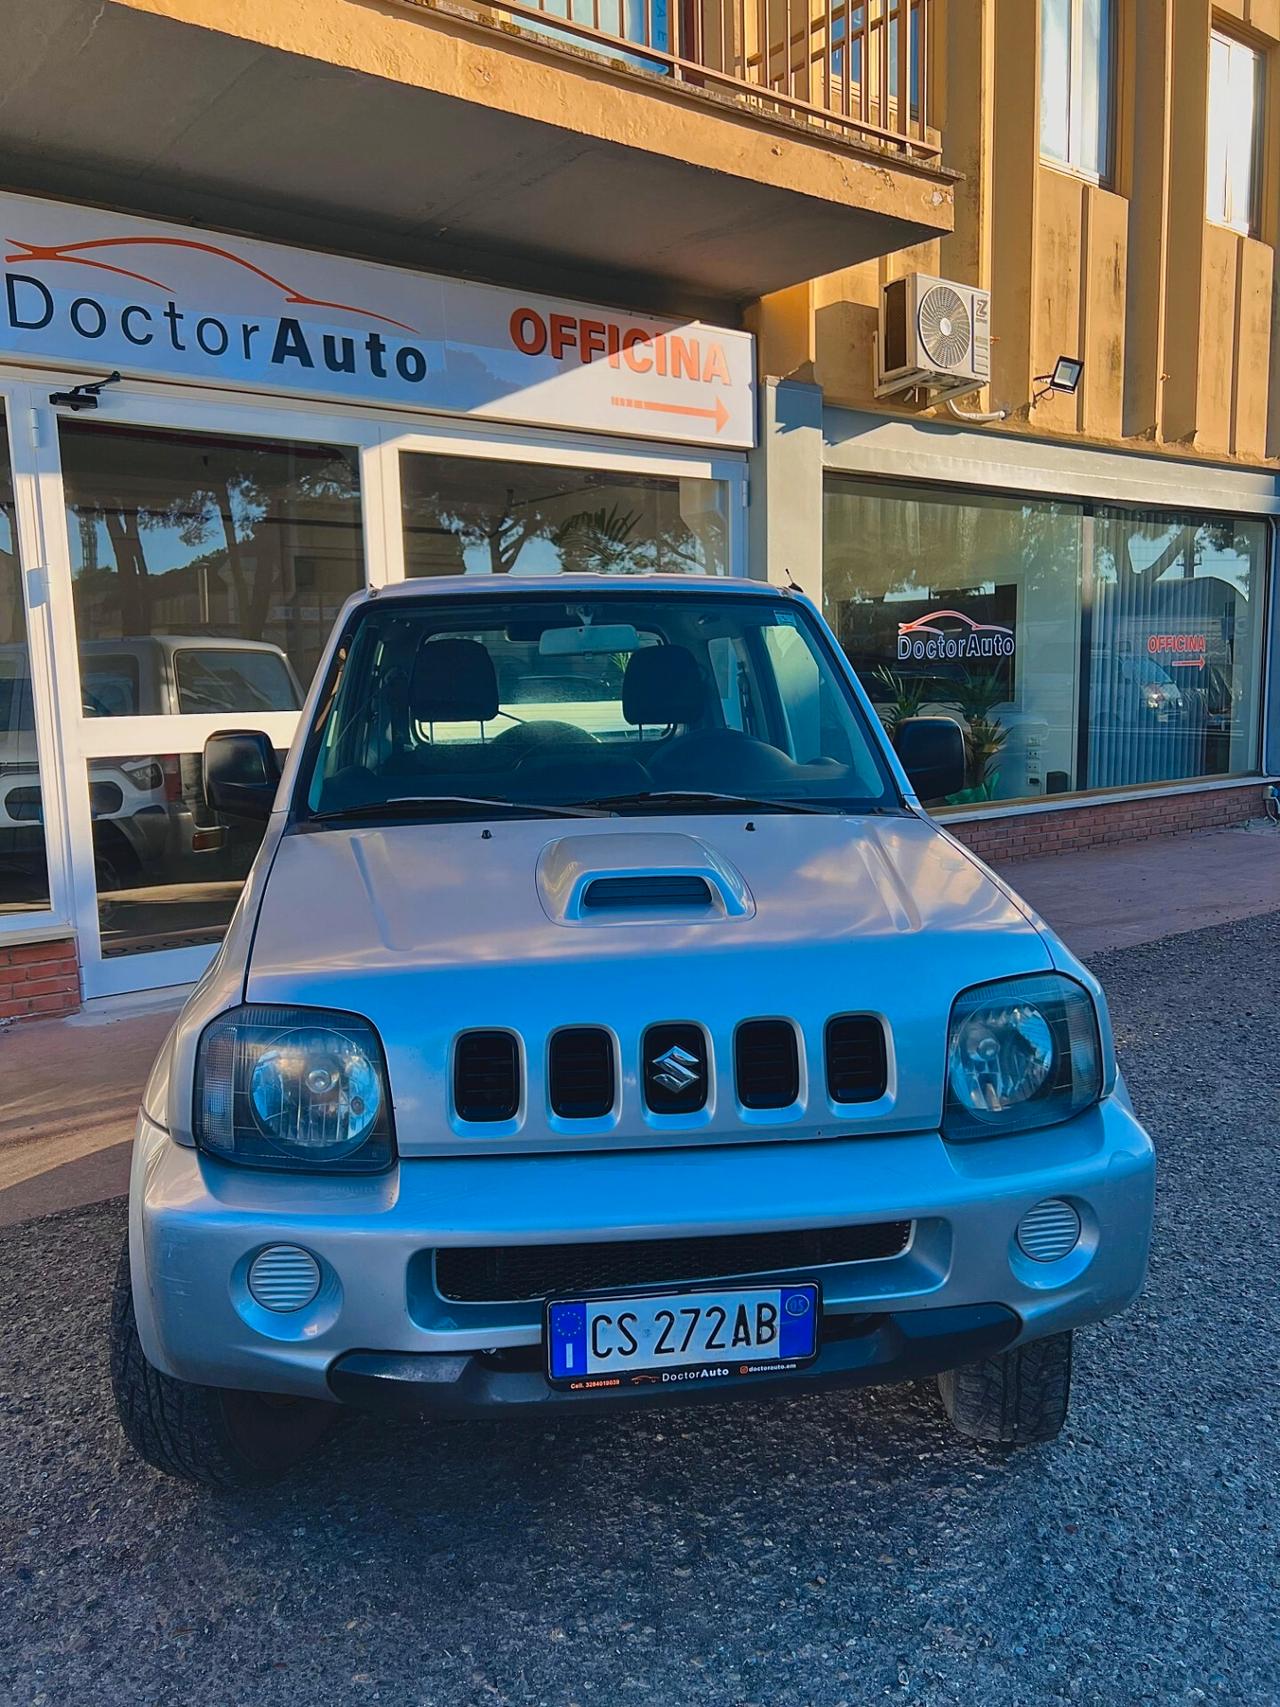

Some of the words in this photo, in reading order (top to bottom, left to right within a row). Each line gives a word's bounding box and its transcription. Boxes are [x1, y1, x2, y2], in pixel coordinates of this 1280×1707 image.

[5, 273, 427, 383] DoctorAuto
[509, 307, 732, 386] OFFICINA
[897, 634, 1015, 660] DoctorAuto
[1147, 634, 1206, 653] OFFICINA
[591, 1312, 638, 1359] CS
[653, 1302, 778, 1355] 272AB
[662, 1367, 730, 1383] DoctorAuto
